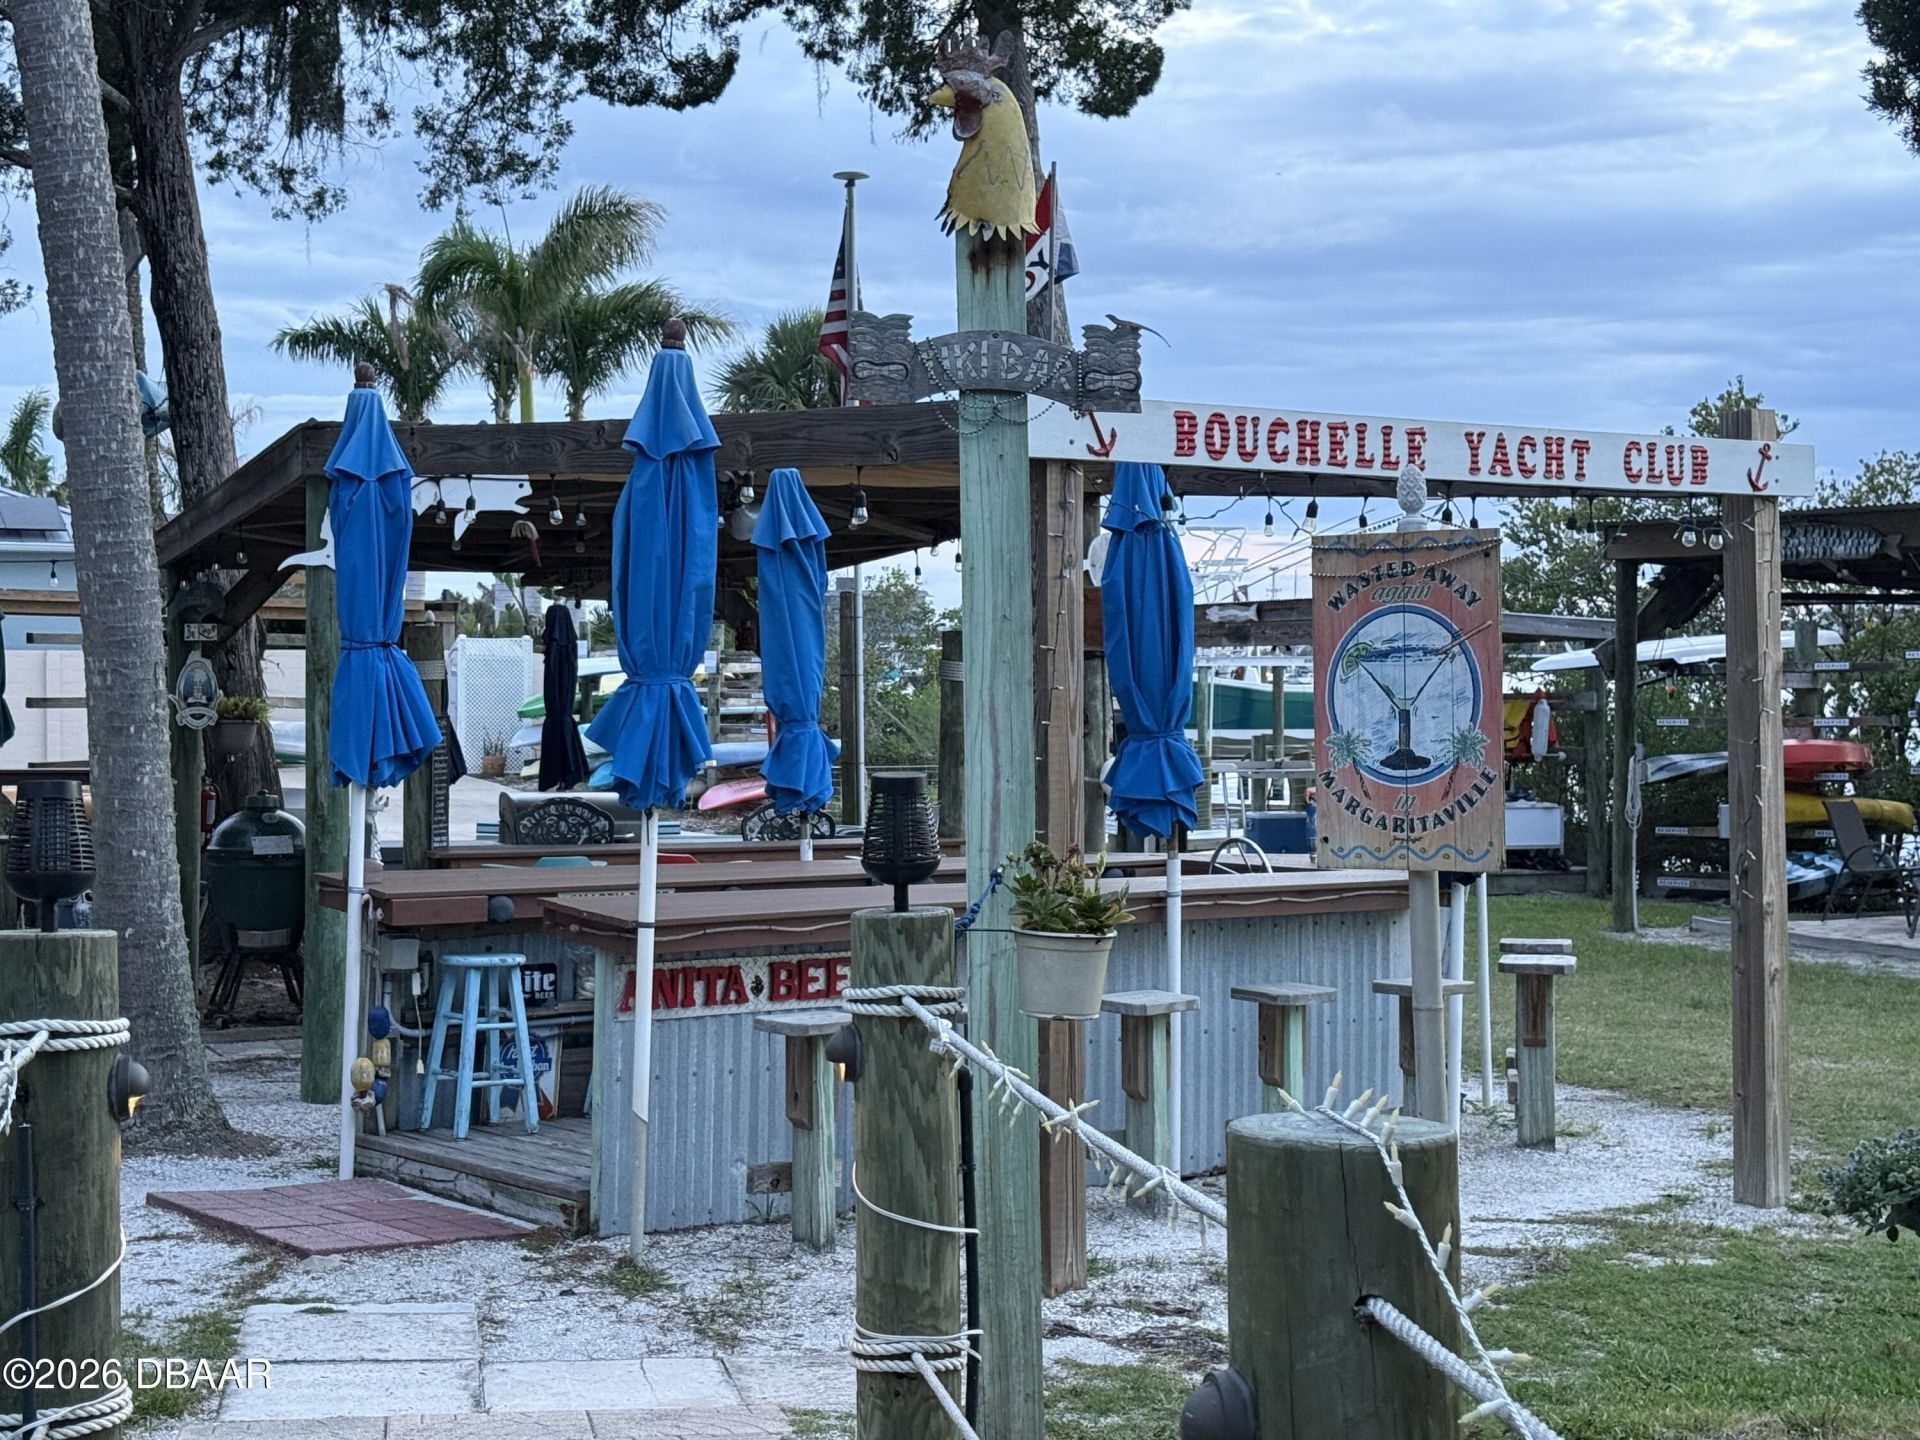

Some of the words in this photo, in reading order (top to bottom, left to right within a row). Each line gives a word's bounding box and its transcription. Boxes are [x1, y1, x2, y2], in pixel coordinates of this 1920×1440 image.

[1000, 341, 1073, 391] BAR
[1173, 410, 1427, 471] BOUCHELLE
[1464, 431, 1591, 481] YACHT
[1623, 440, 1709, 486] CLUB
[1326, 560, 1416, 612] WASTED
[1422, 564, 1483, 608] AWAY
[1371, 583, 1431, 603] again
[1318, 767, 1498, 834] MARGARITAVILLE
[1394, 792, 1416, 811] in
[523, 970, 556, 992] ite
[618, 965, 750, 1013] ANITA
[768, 957, 852, 1001] BEE
